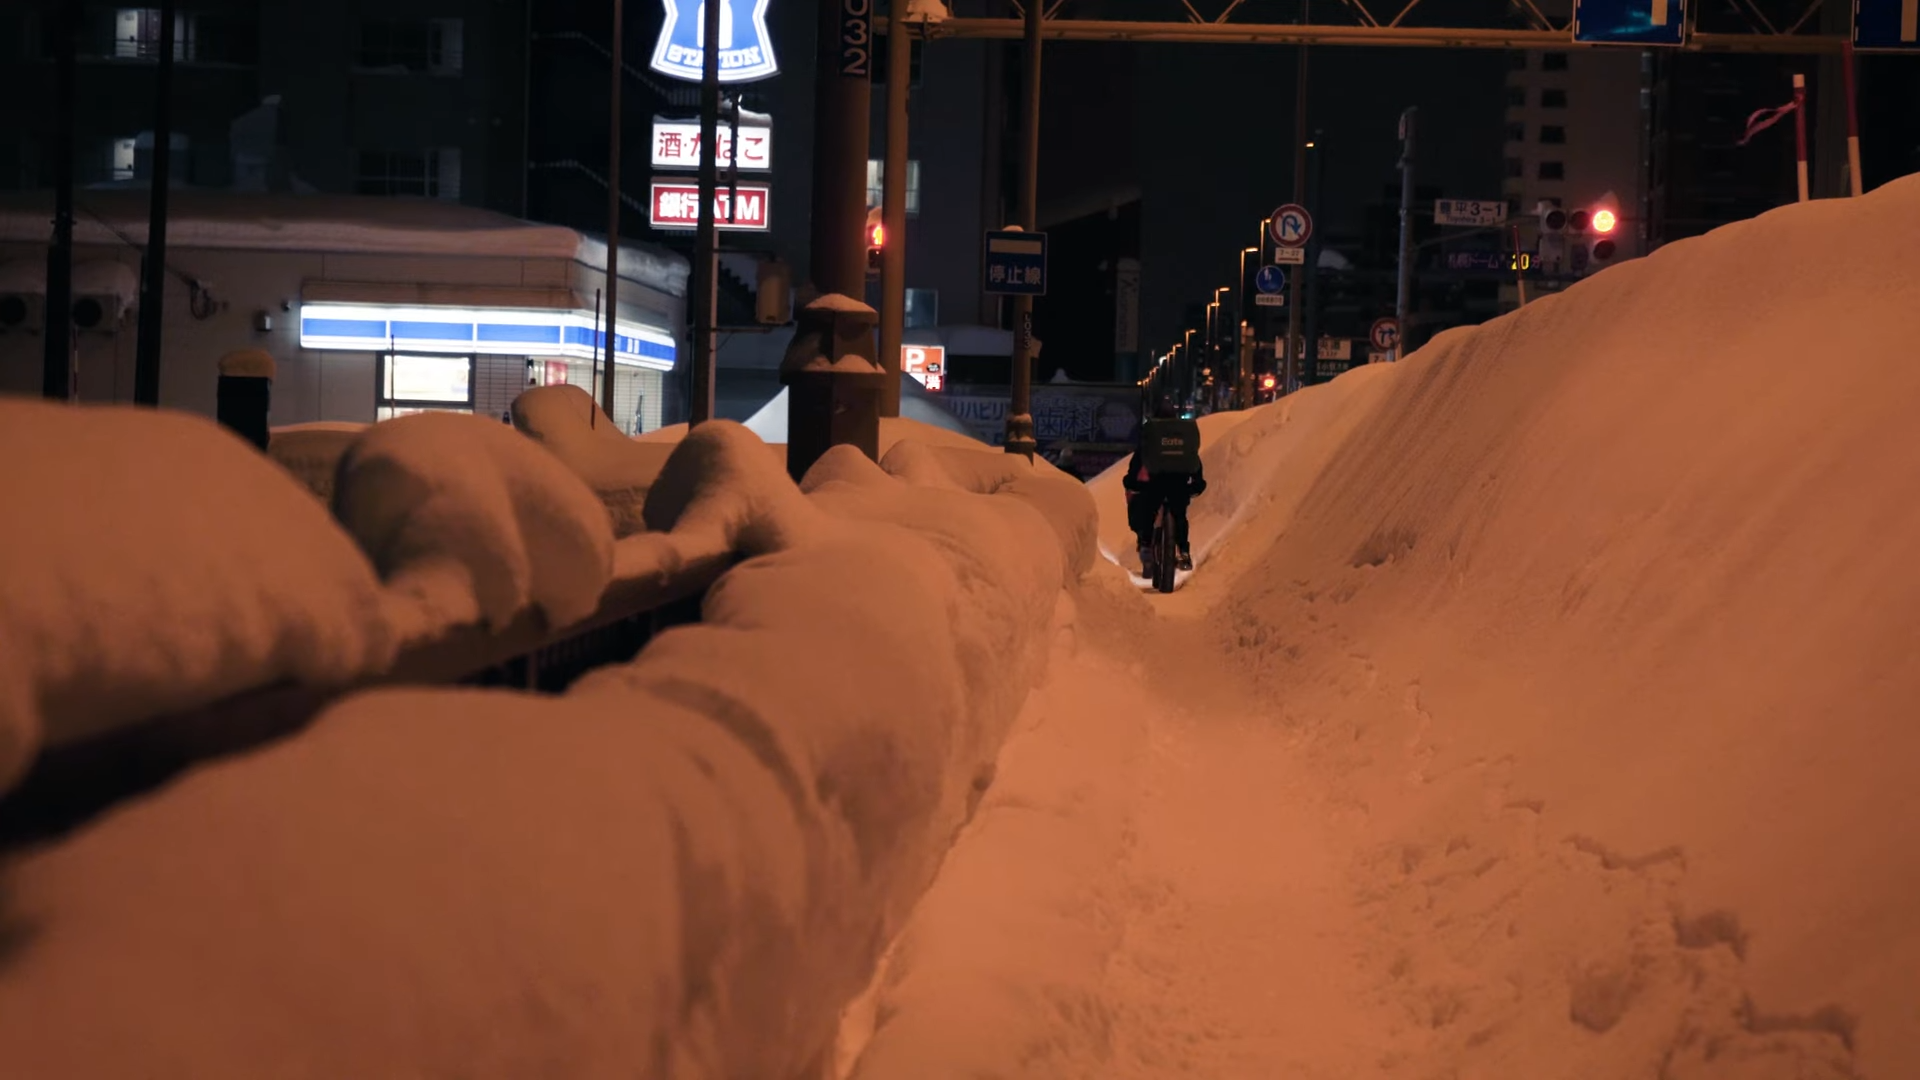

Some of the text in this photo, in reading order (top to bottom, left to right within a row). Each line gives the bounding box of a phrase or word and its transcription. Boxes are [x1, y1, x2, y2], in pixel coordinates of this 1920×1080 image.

[666, 44, 762, 69] STAION
[989, 264, 1041, 285] 停止線
[906, 348, 925, 372] P
[1034, 406, 1098, 441] 歯科
